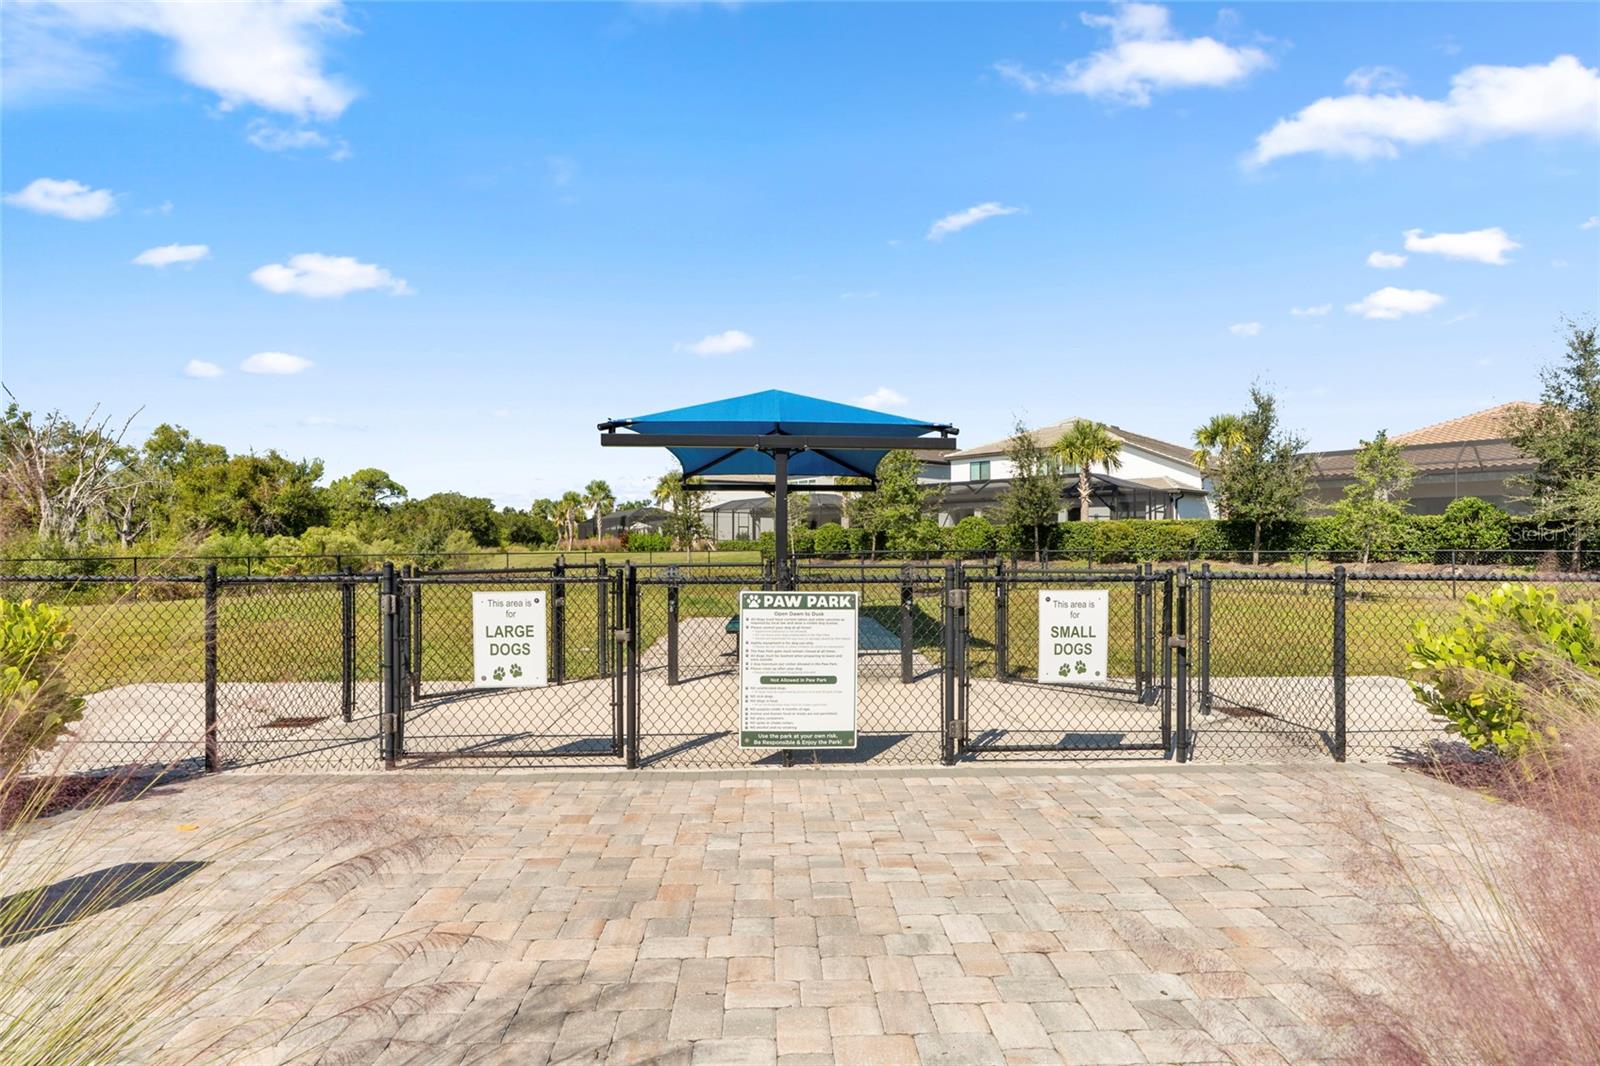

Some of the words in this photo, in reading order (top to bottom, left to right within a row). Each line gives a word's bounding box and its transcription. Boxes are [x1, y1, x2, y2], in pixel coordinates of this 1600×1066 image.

[488, 599, 504, 607] This
[525, 599, 532, 607] is
[764, 596, 802, 607] PAW
[807, 596, 851, 607] PARK
[486, 625, 534, 638] LARGE
[1050, 626, 1096, 638] SMALL
[490, 643, 530, 656] DOGS
[1054, 643, 1092, 655] DOGS
